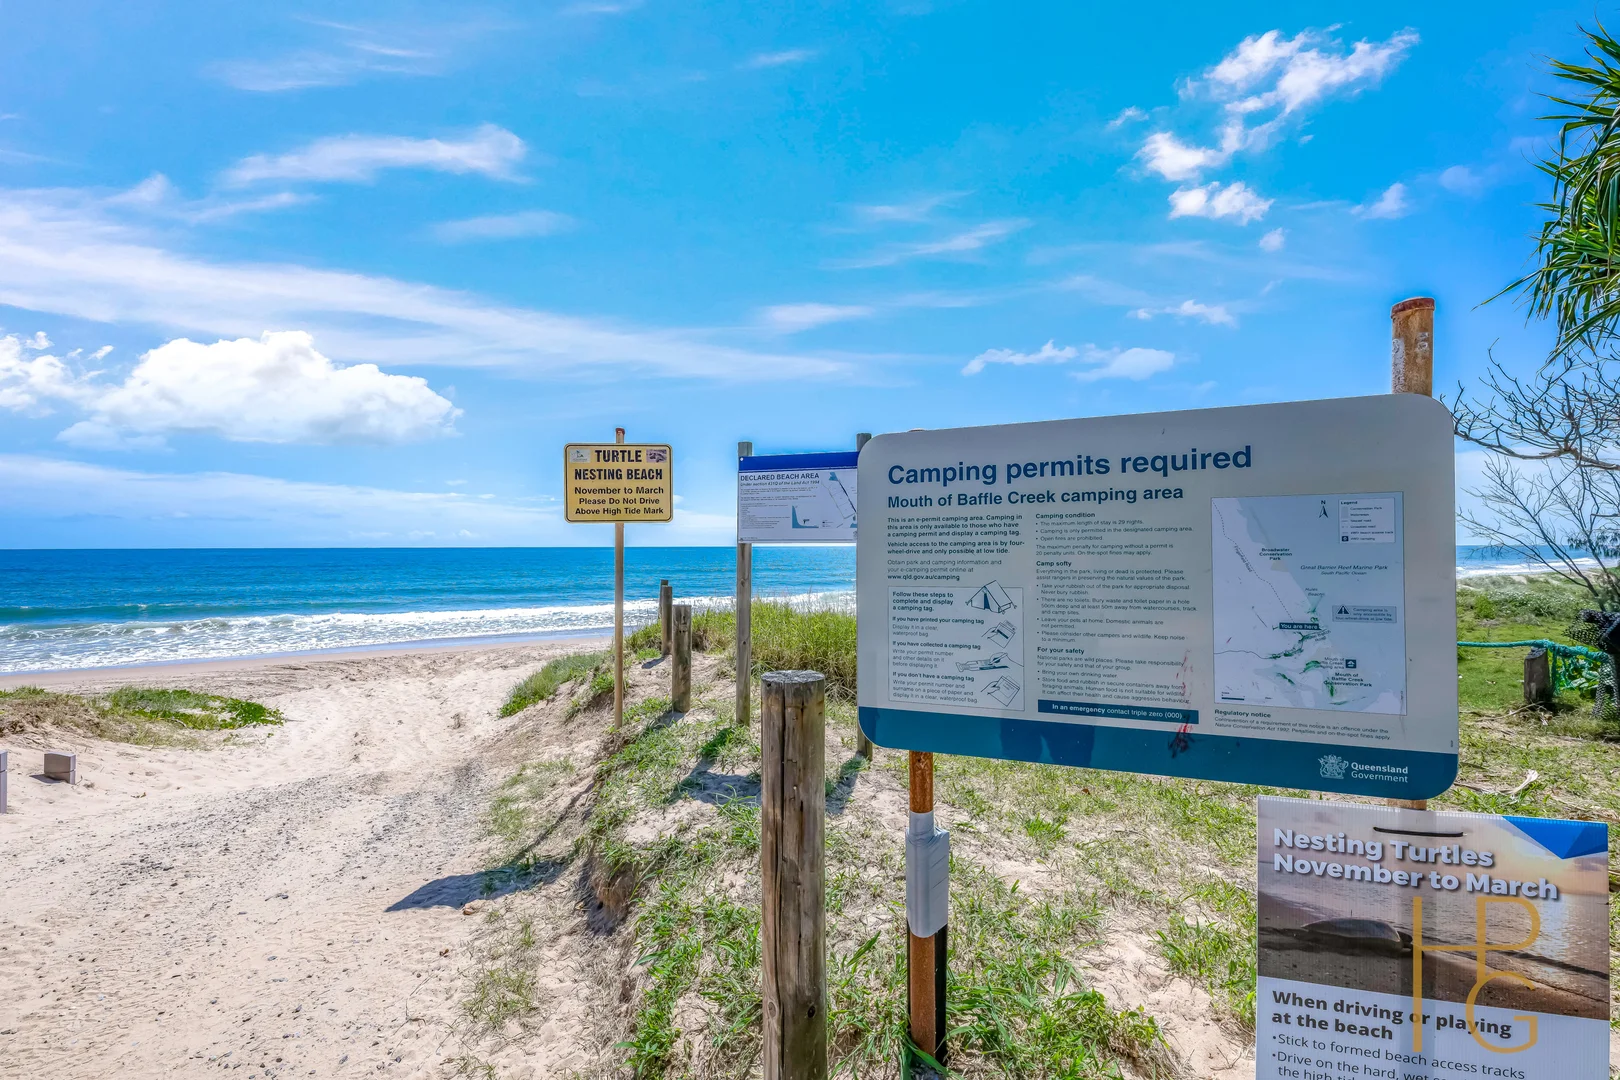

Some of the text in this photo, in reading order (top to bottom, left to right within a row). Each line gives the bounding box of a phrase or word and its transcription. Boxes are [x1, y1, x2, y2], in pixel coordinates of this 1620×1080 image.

[594, 449, 642, 463] TURTLE
[888, 445, 1251, 487] Camping permits required
[574, 468, 663, 480] NESTING BEACH
[579, 497, 606, 505] Please
[608, 497, 620, 505] Do
[888, 488, 1183, 508] Mouth of Baffle Creek camping area
[602, 508, 622, 516] High
[1069, 706, 1106, 714] emergency
[1106, 707, 1130, 715] contact
[1131, 709, 1147, 717] triple
[1164, 711, 1182, 720] (000)
[1215, 710, 1249, 718] Regulatory
[1351, 762, 1408, 774] Queensland
[1351, 770, 1408, 783] Government
[1273, 828, 1494, 867] Nesting Turtles
[1273, 853, 1558, 899] November to March
[1272, 990, 1512, 1039] When driving or playing
[1271, 1012, 1393, 1040] at the beach
[1278, 1033, 1525, 1079] Stick to formed beach access tracks
[1277, 1051, 1312, 1066] Drive
[1315, 1059, 1333, 1069] on
[1337, 1061, 1359, 1074] the
[1364, 1064, 1399, 1080] hard,
[1278, 1066, 1299, 1078] the
